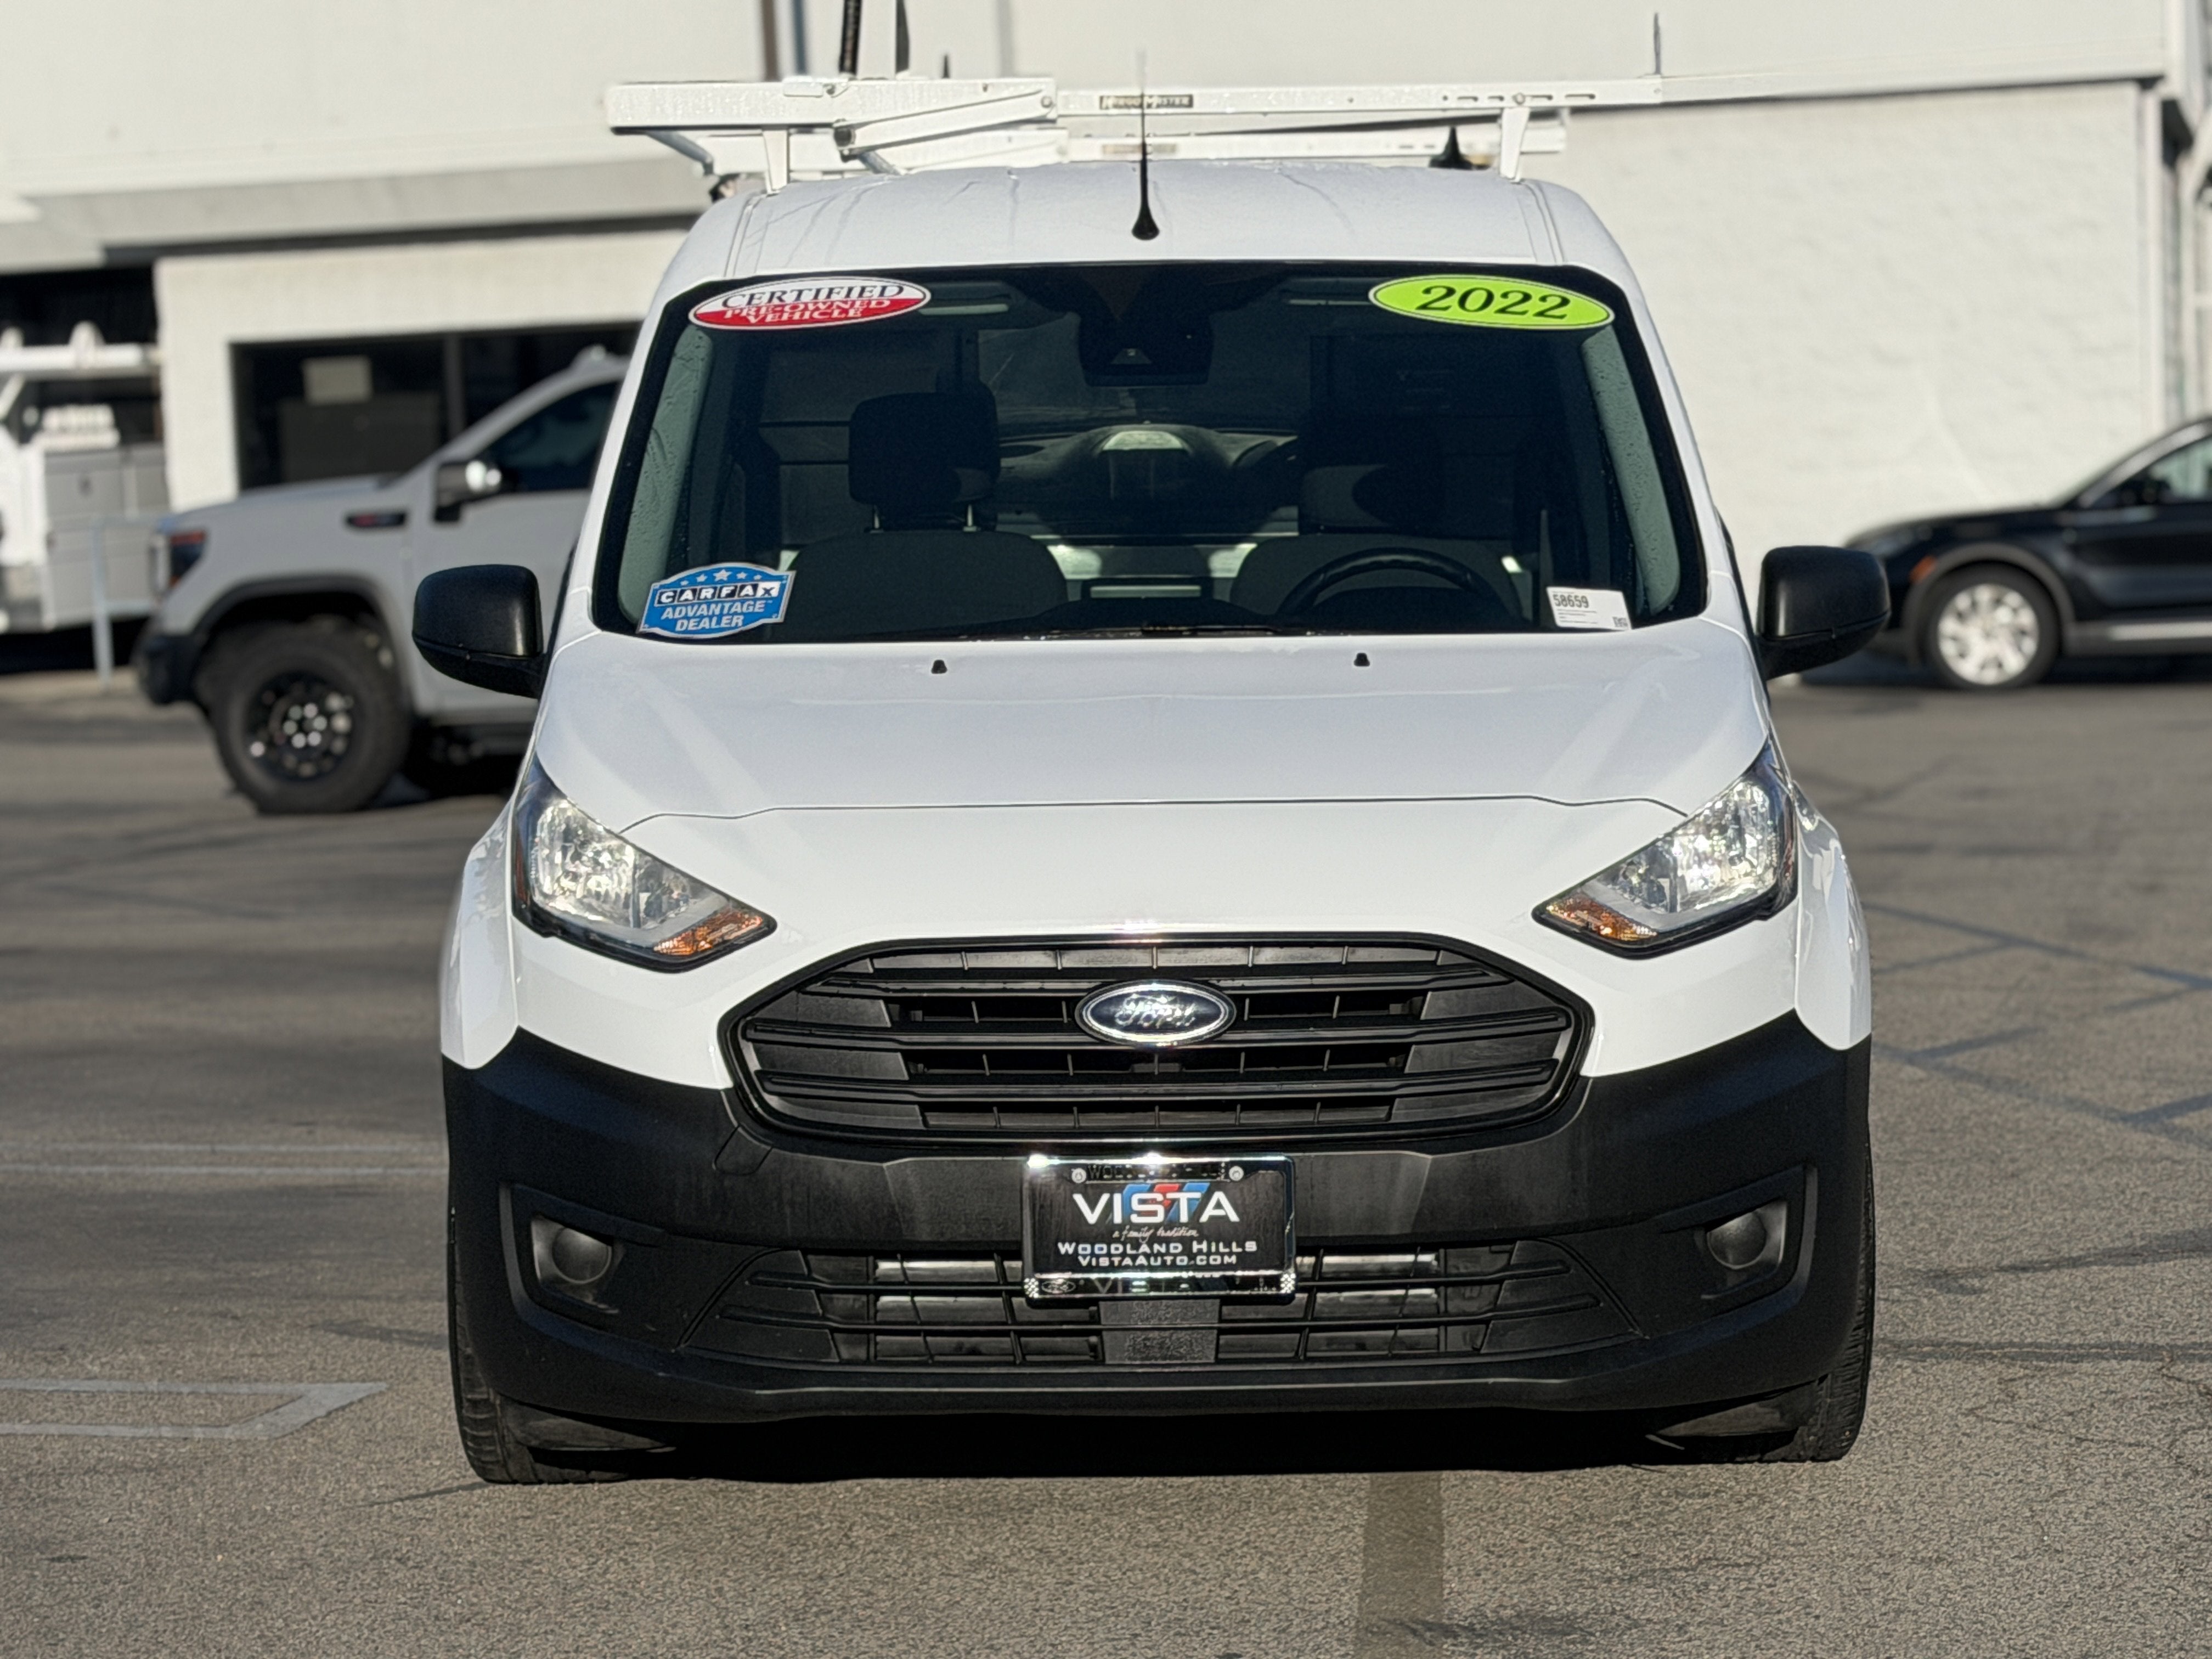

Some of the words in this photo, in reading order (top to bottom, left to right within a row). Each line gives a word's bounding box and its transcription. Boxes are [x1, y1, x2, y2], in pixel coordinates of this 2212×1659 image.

[721, 285, 904, 309] CERTIFIED
[1415, 285, 1571, 320] 2022
[724, 300, 891, 319] PRE-OWNED
[746, 308, 863, 324] VEHICLE
[660, 584, 775, 603] CARFAX
[1553, 594, 1589, 608] 58659
[661, 601, 766, 619] ADVANTAGE
[675, 614, 744, 631] DEALER
[1114, 993, 1197, 1030] Ford
[1072, 1190, 1240, 1224] VISTA
[1120, 1225, 1155, 1244] family
